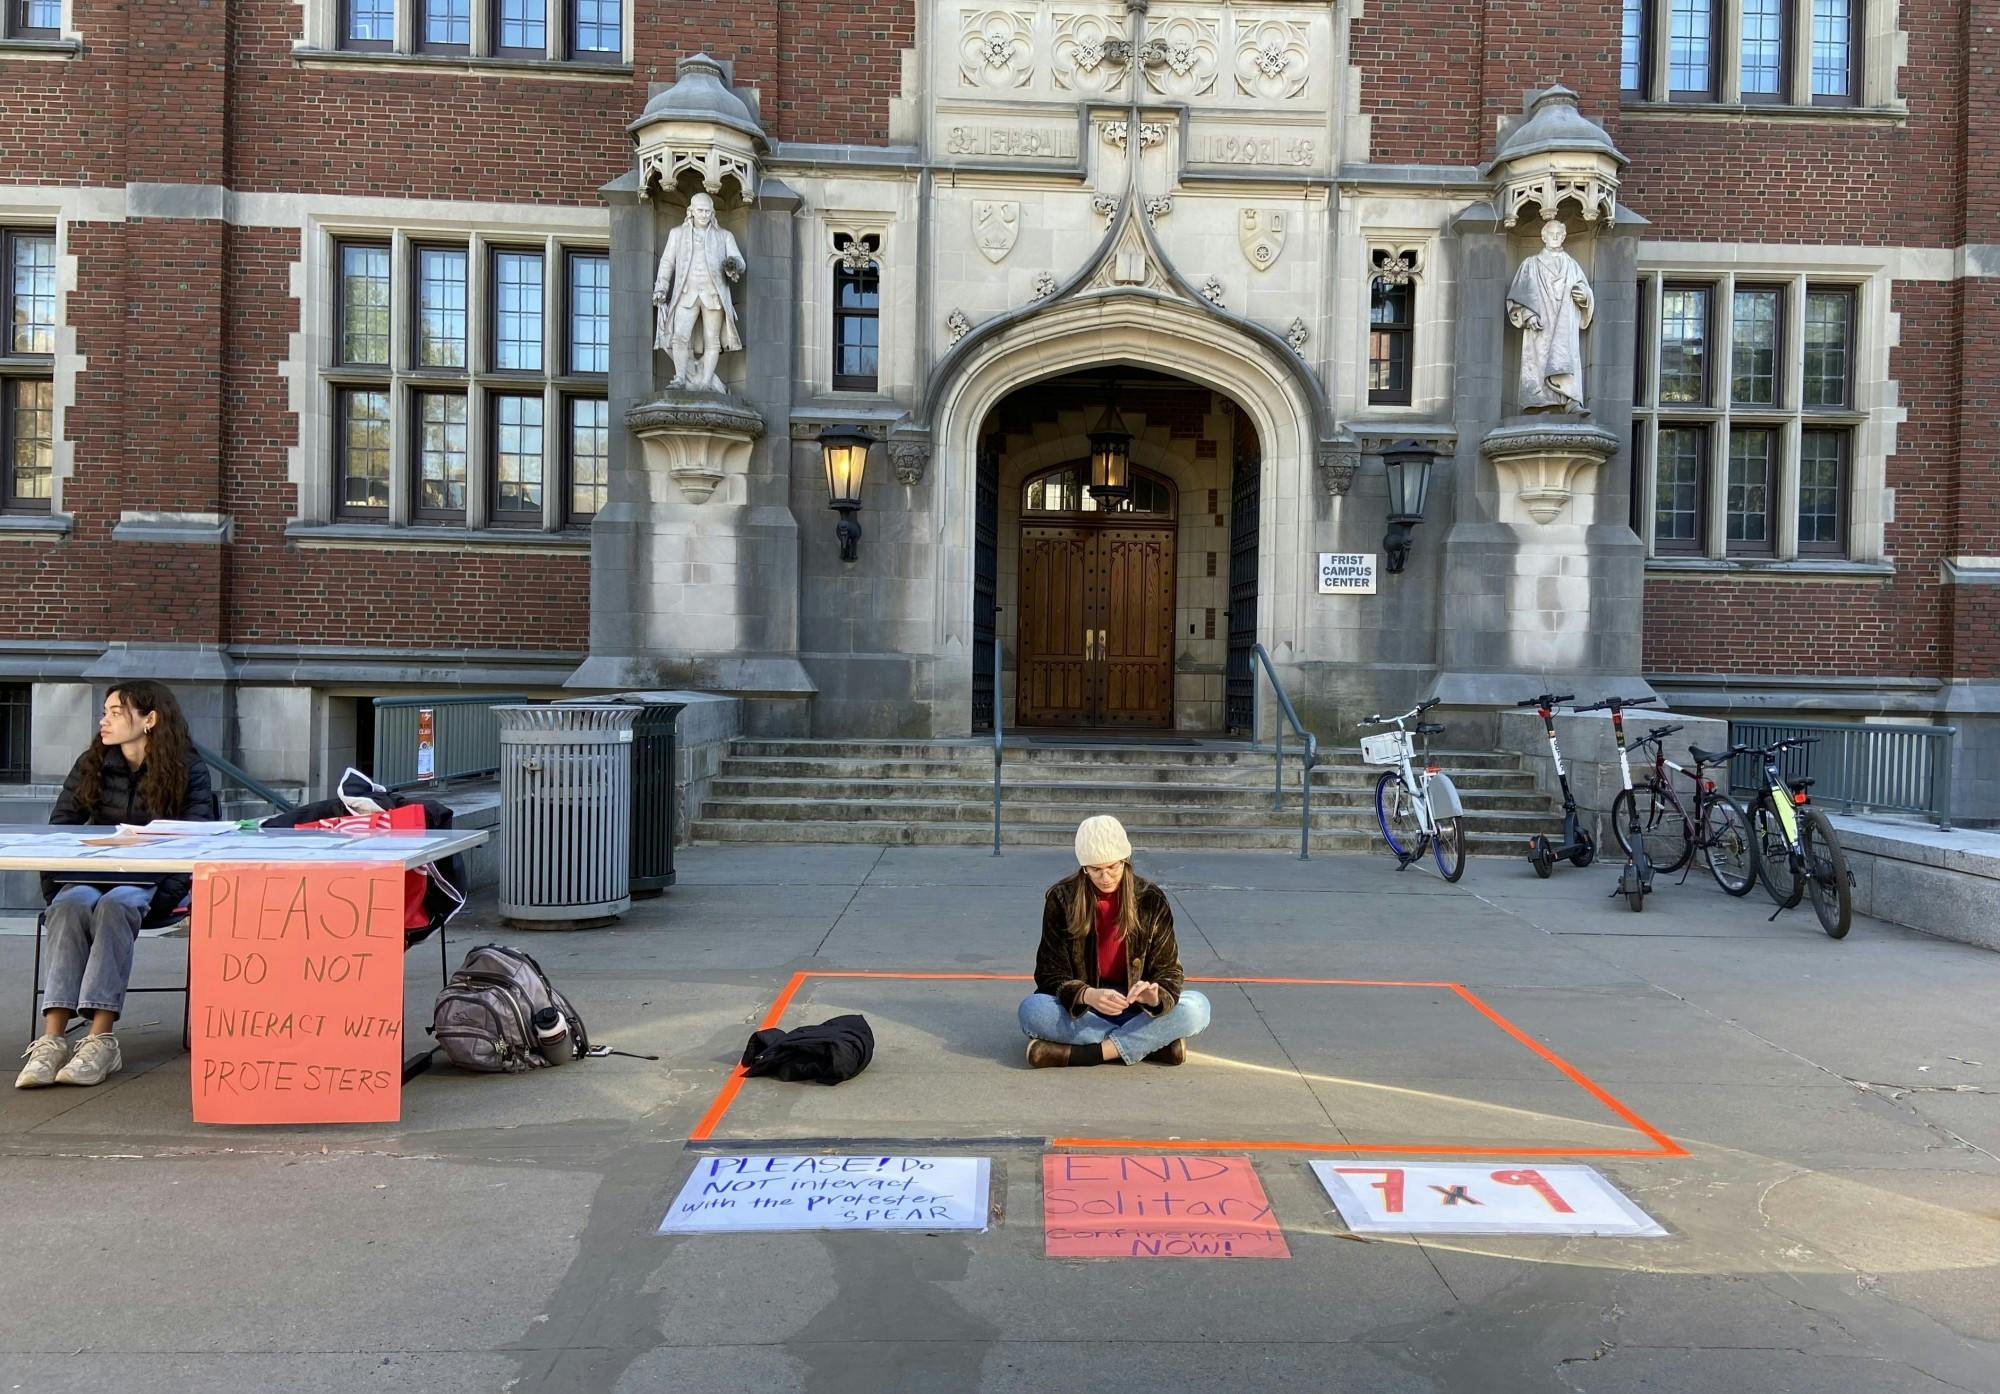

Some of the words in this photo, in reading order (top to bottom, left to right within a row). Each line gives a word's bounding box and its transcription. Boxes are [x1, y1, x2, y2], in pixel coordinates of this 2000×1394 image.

[1331, 555, 1364, 565] FRIST
[1322, 566, 1372, 576] CAMPUS
[1324, 577, 1370, 587] CENTER
[208, 875, 399, 941] PLEASE
[223, 952, 268, 985] DO
[304, 953, 373, 983] NOT
[205, 1005, 327, 1040] INTERACT
[344, 1015, 402, 1041] WITH
[709, 1157, 892, 1178] PLEASE!
[1066, 1155, 1230, 1183] END
[702, 1176, 788, 1196] NOT
[790, 1175, 920, 1193] interact
[1333, 1168, 1405, 1213] 7
[1489, 1169, 1578, 1213] 9
[681, 1196, 736, 1214] with
[749, 1196, 796, 1209] the
[807, 1193, 956, 1212] protester
[1132, 1239, 1233, 1257] NOW!
